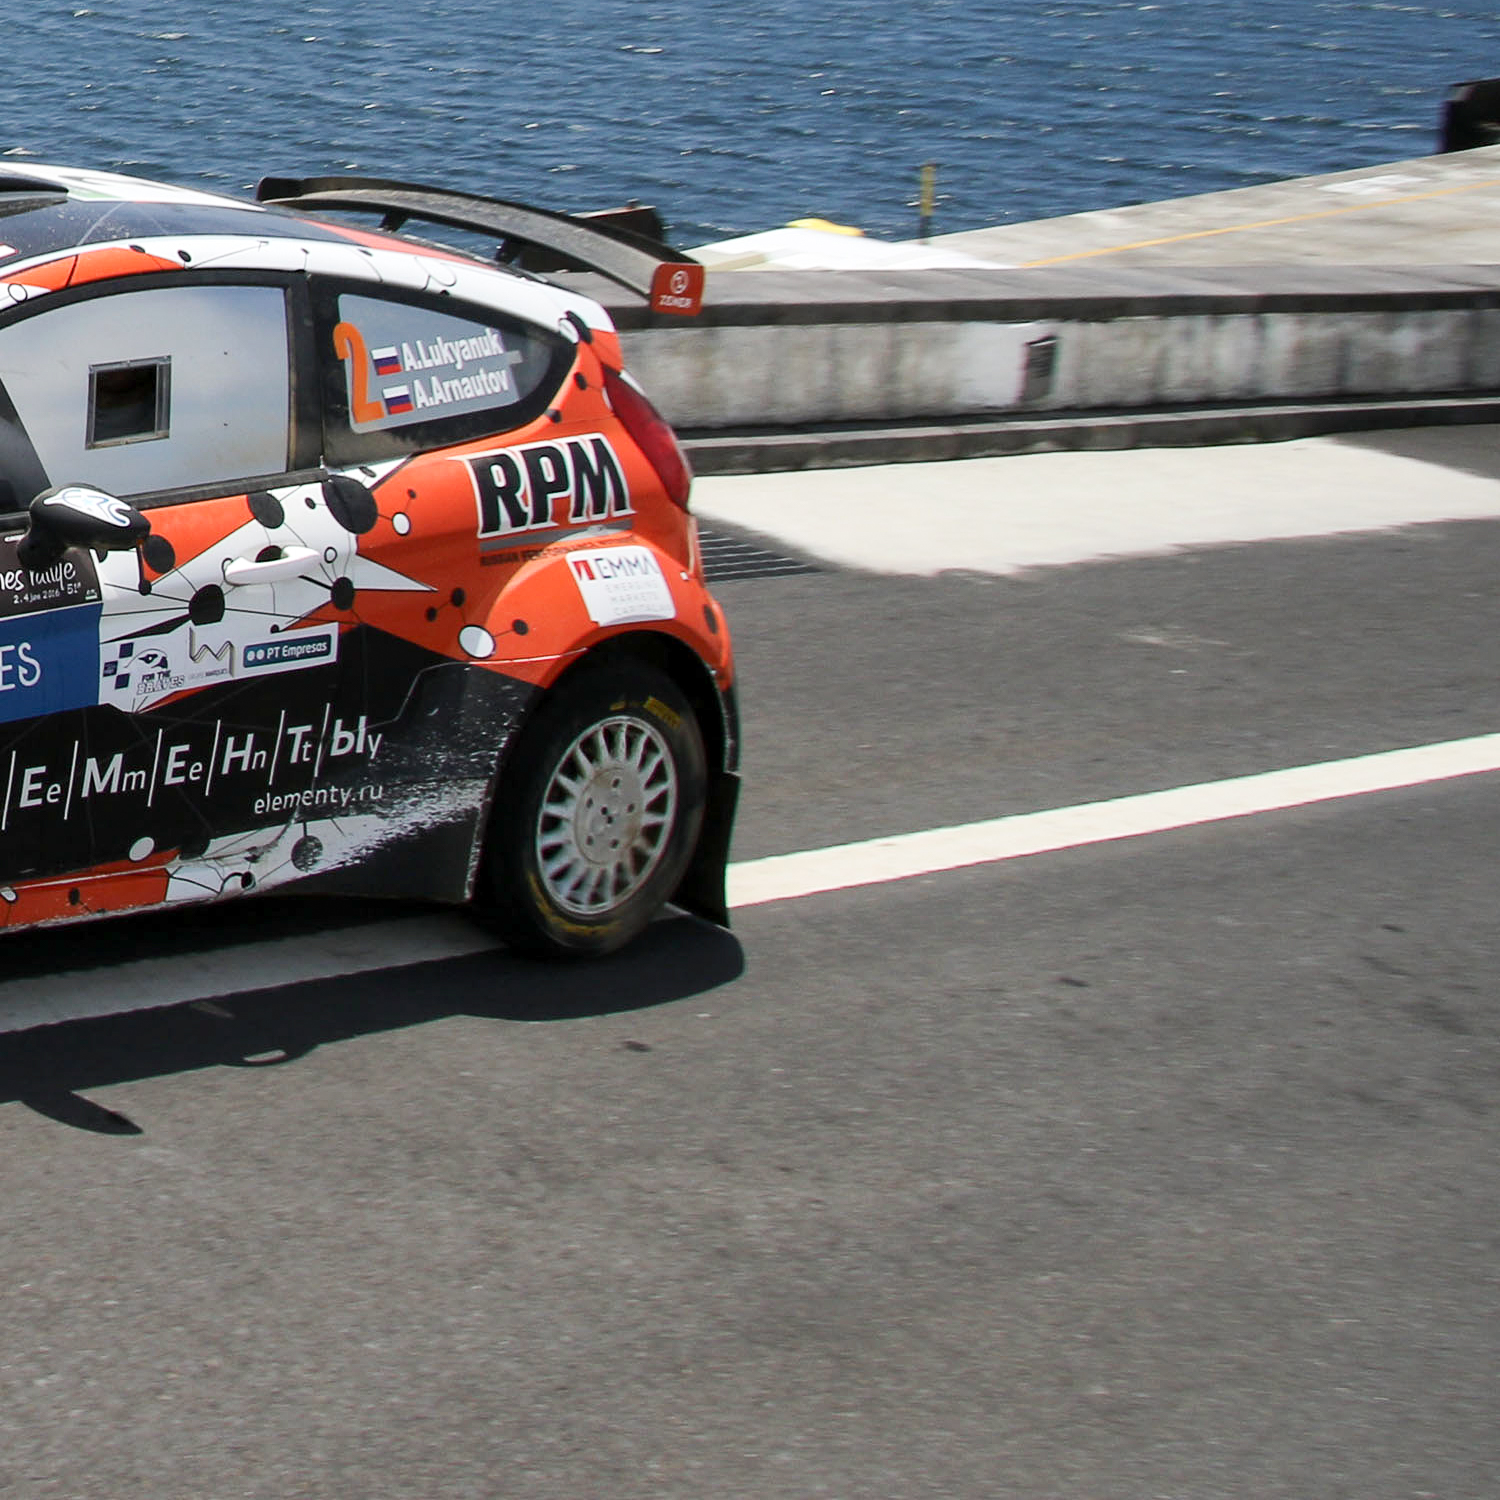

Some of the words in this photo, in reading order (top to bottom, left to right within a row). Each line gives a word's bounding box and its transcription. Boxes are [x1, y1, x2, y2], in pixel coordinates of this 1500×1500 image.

[401, 326, 505, 372] A.Lukyanuk
[333, 322, 385, 424] 2
[413, 367, 510, 409] A.Arnautov
[470, 438, 630, 536] RPM
[594, 554, 660, 580] EMMA
[266, 646, 281, 660] PT
[282, 639, 329, 658] Empresas
[253, 781, 385, 817] elementy.ru
